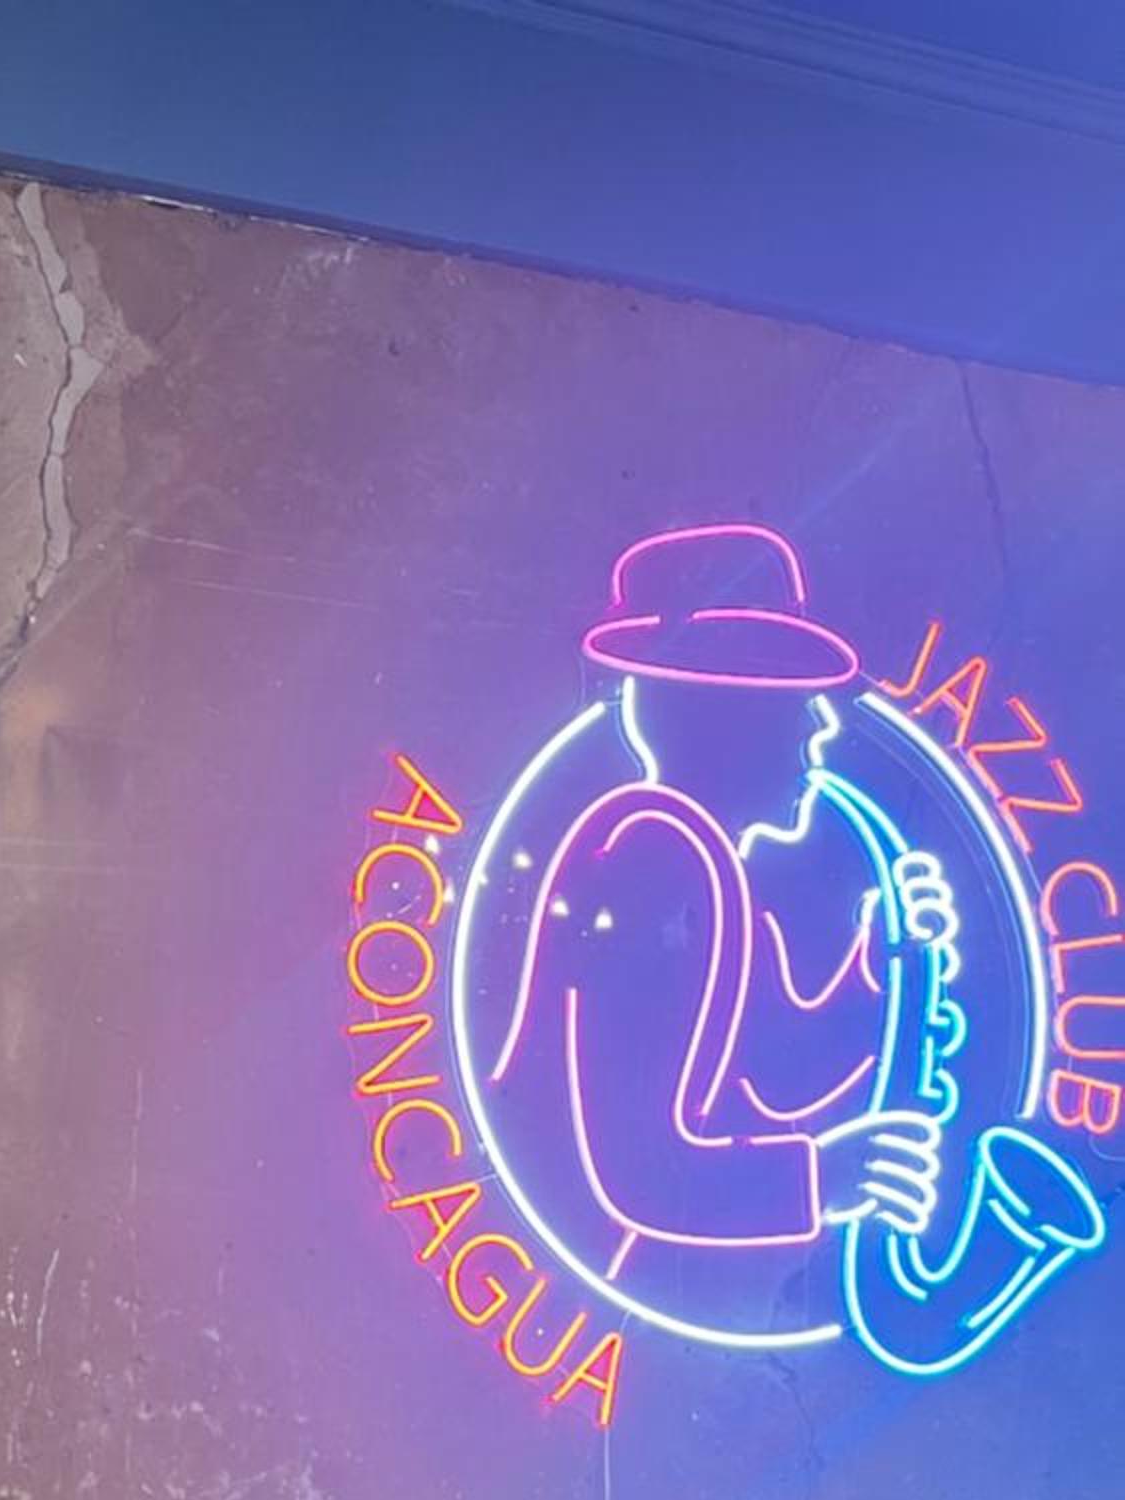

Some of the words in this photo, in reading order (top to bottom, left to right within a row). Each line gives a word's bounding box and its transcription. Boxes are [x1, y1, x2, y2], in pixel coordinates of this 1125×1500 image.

[347, 754, 623, 1428] ACONCAGUA
[877, 620, 1083, 856] JAZZ
[1040, 861, 1125, 1135] CLUB
